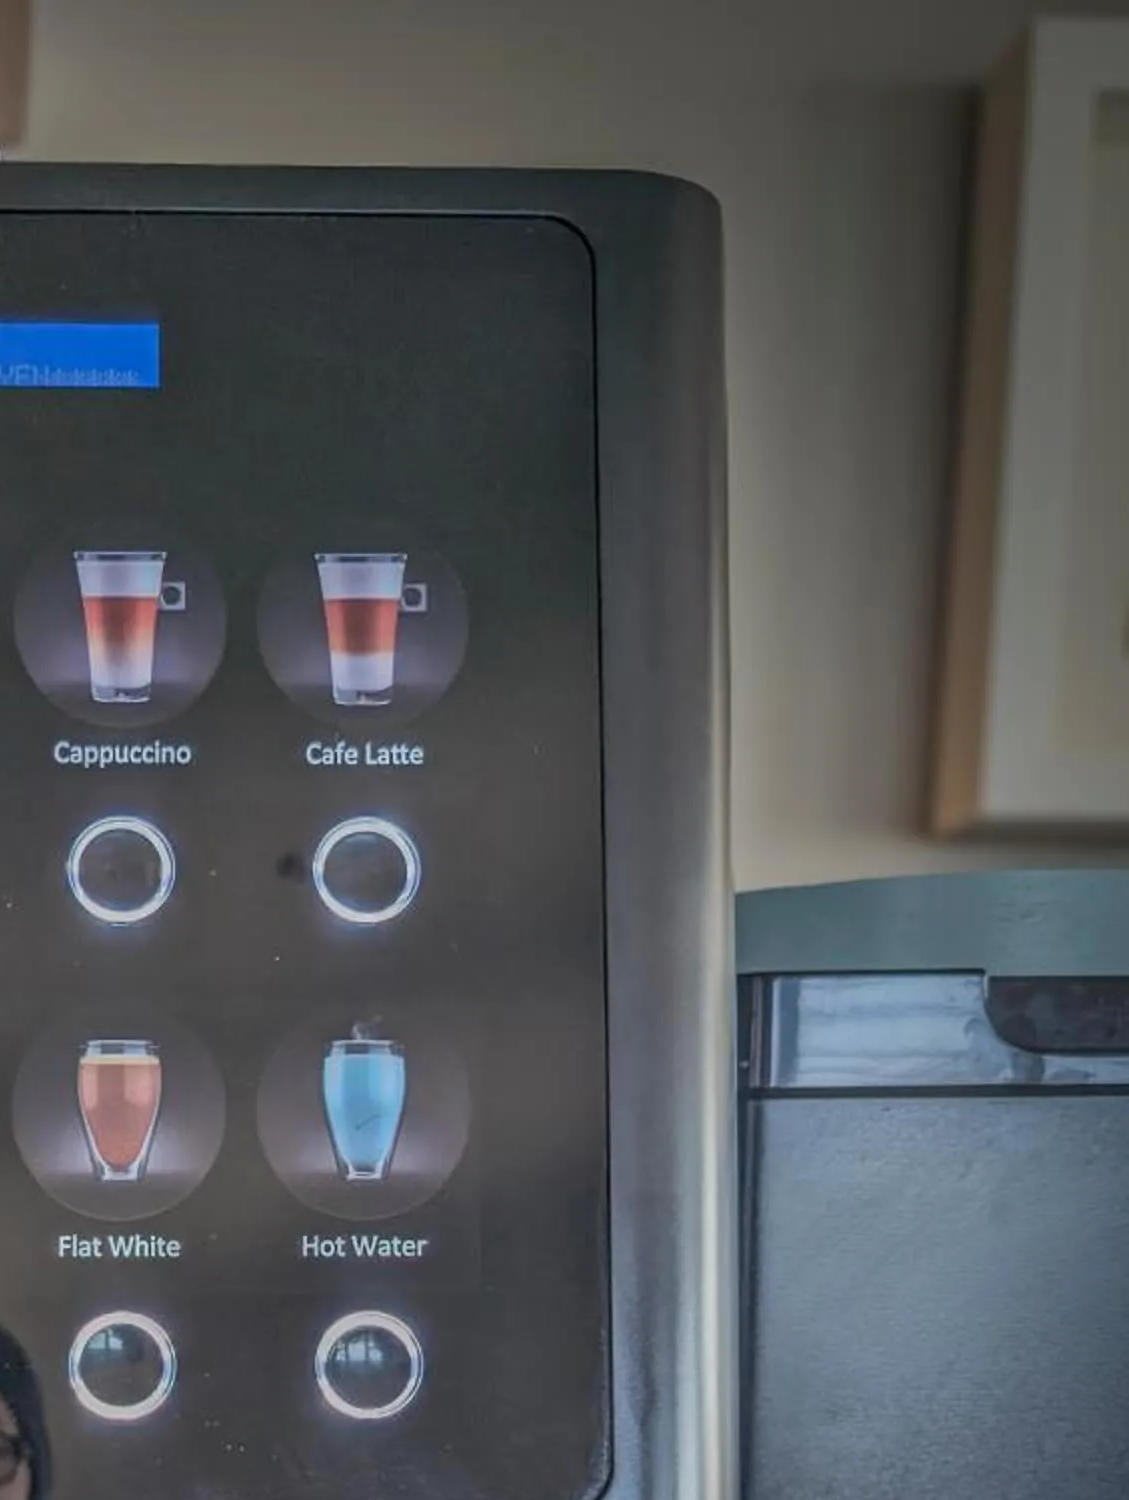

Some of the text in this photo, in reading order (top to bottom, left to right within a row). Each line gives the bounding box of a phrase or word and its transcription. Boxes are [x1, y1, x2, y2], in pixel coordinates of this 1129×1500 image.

[54, 739, 192, 768] Cappuccino
[305, 742, 424, 766] Cafe Latte
[58, 1235, 182, 1258] Flat White
[301, 1234, 428, 1258] Hot Water
